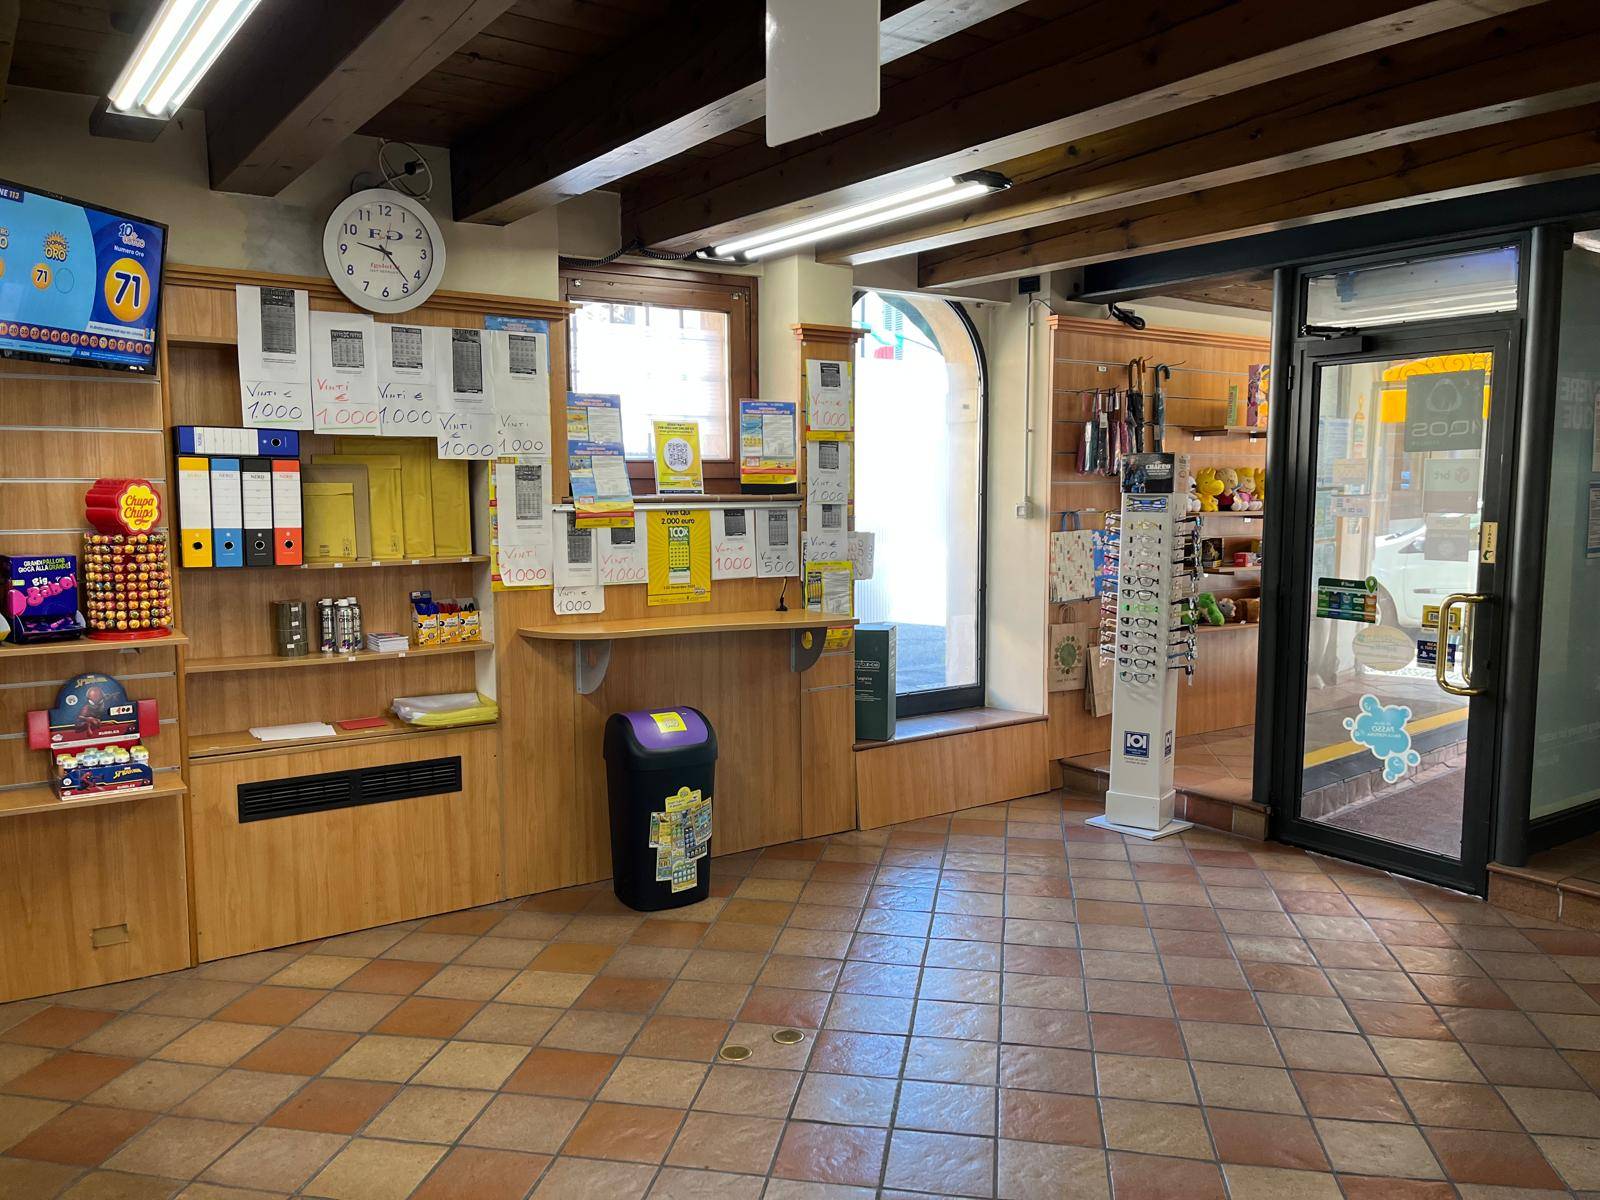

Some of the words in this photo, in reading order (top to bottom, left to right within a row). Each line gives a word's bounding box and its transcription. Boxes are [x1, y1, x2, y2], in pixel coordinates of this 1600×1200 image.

[359, 209, 371, 221] 11
[378, 205, 392, 217] 12
[401, 212, 406, 223] 1
[343, 223, 357, 235] 10
[415, 228, 422, 239] 2
[45, 247, 67, 261] ORO
[340, 243, 347, 254] 9
[420, 249, 427, 260] 3
[347, 264, 354, 275] 8
[413, 270, 421, 280] 4
[36, 269, 48, 283] 71
[114, 271, 142, 308] 71
[363, 281, 370, 291] 7
[402, 283, 409, 294] 5
[382, 287, 389, 297] 6
[248, 401, 303, 420] 1.000
[379, 406, 432, 424] 1.000
[125, 495, 154, 507] Chupa
[123, 506, 153, 525] Chups
[24, 559, 42, 567] GRANDI
[36, 564, 48, 572] ALLA
[764, 561, 795, 573] 500
[32, 576, 48, 587] Big
[27, 573, 78, 607] Babol
